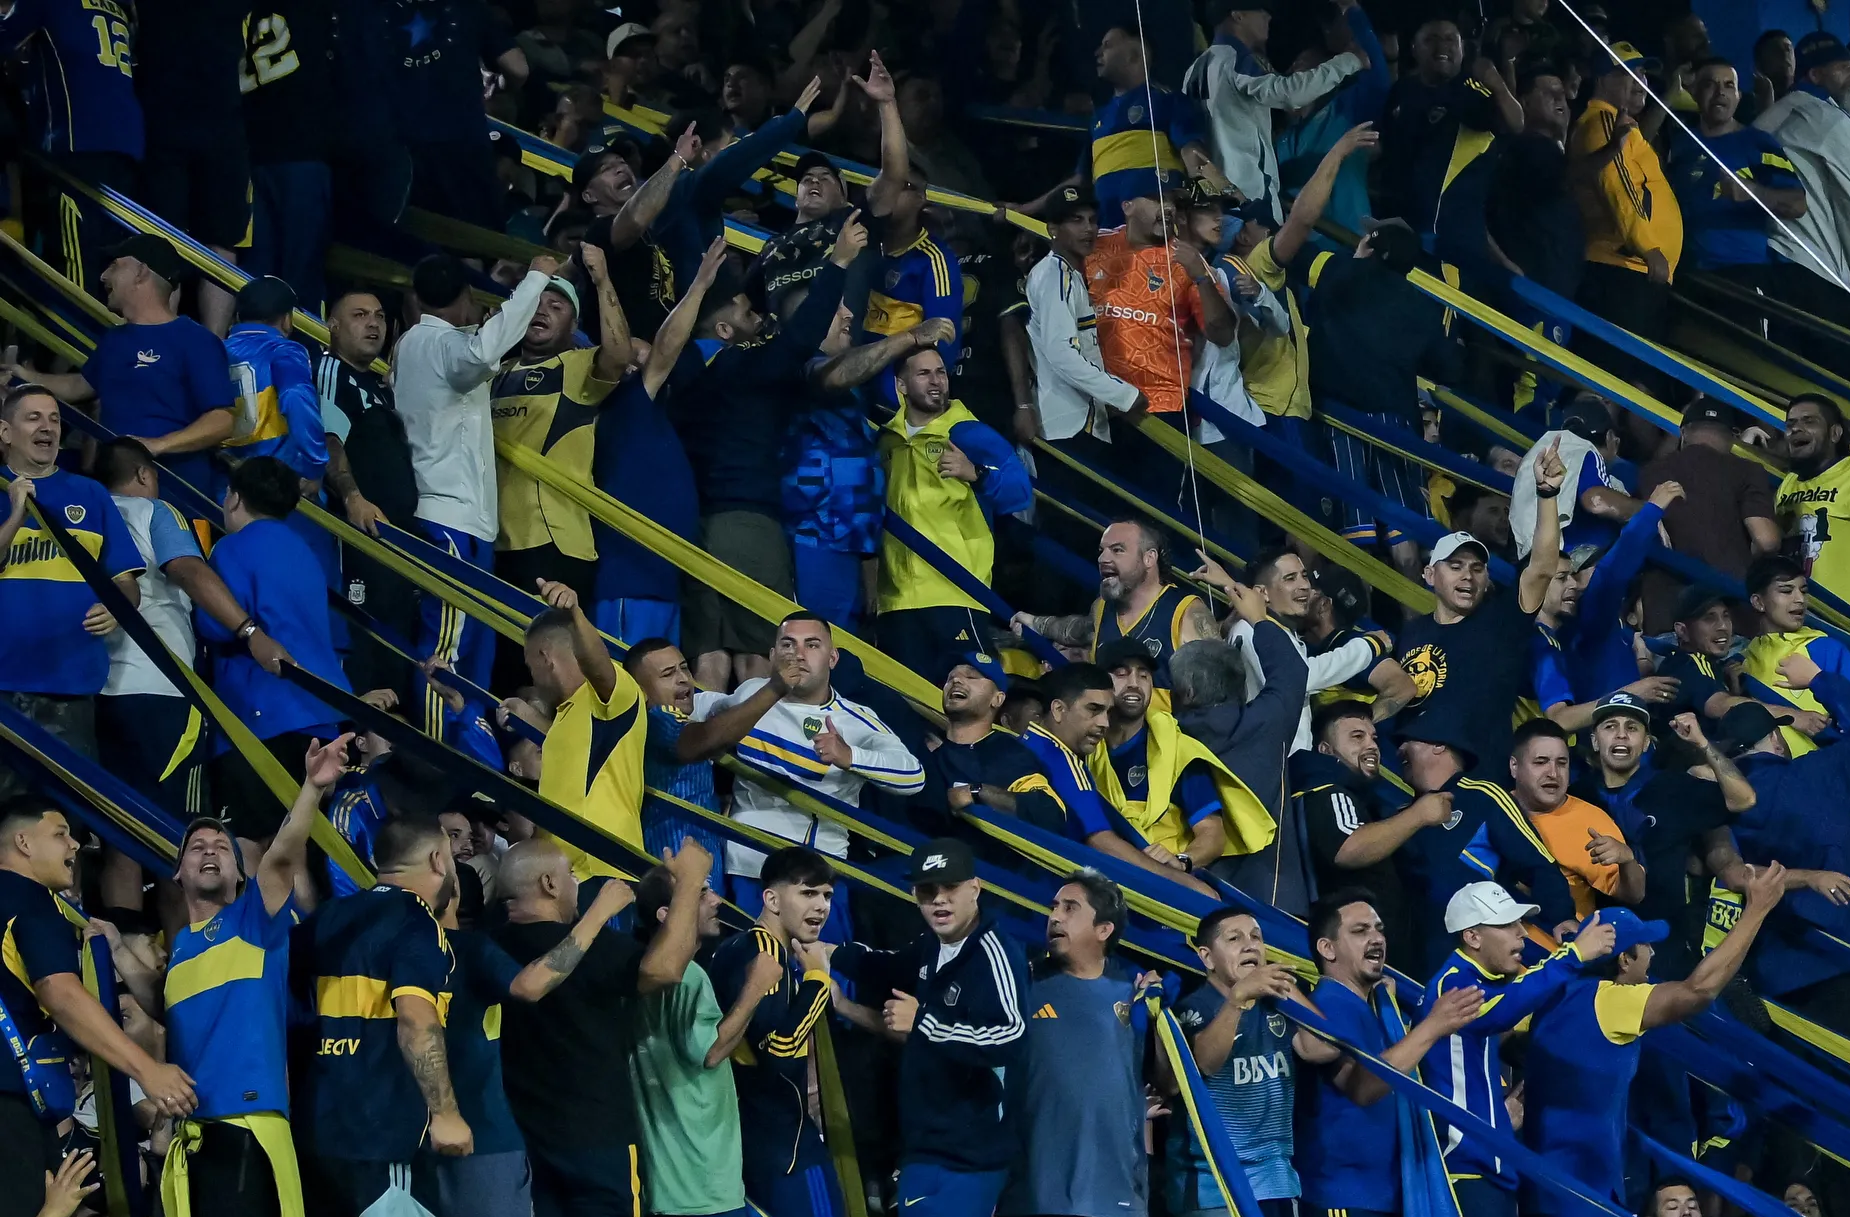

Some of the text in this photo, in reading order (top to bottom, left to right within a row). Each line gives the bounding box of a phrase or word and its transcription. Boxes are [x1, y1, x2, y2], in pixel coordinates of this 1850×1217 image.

[92, 15, 133, 79] 12
[767, 266, 824, 292] etsson
[1096, 302, 1157, 325] etsson
[1231, 1051, 1290, 1085] BBVA
